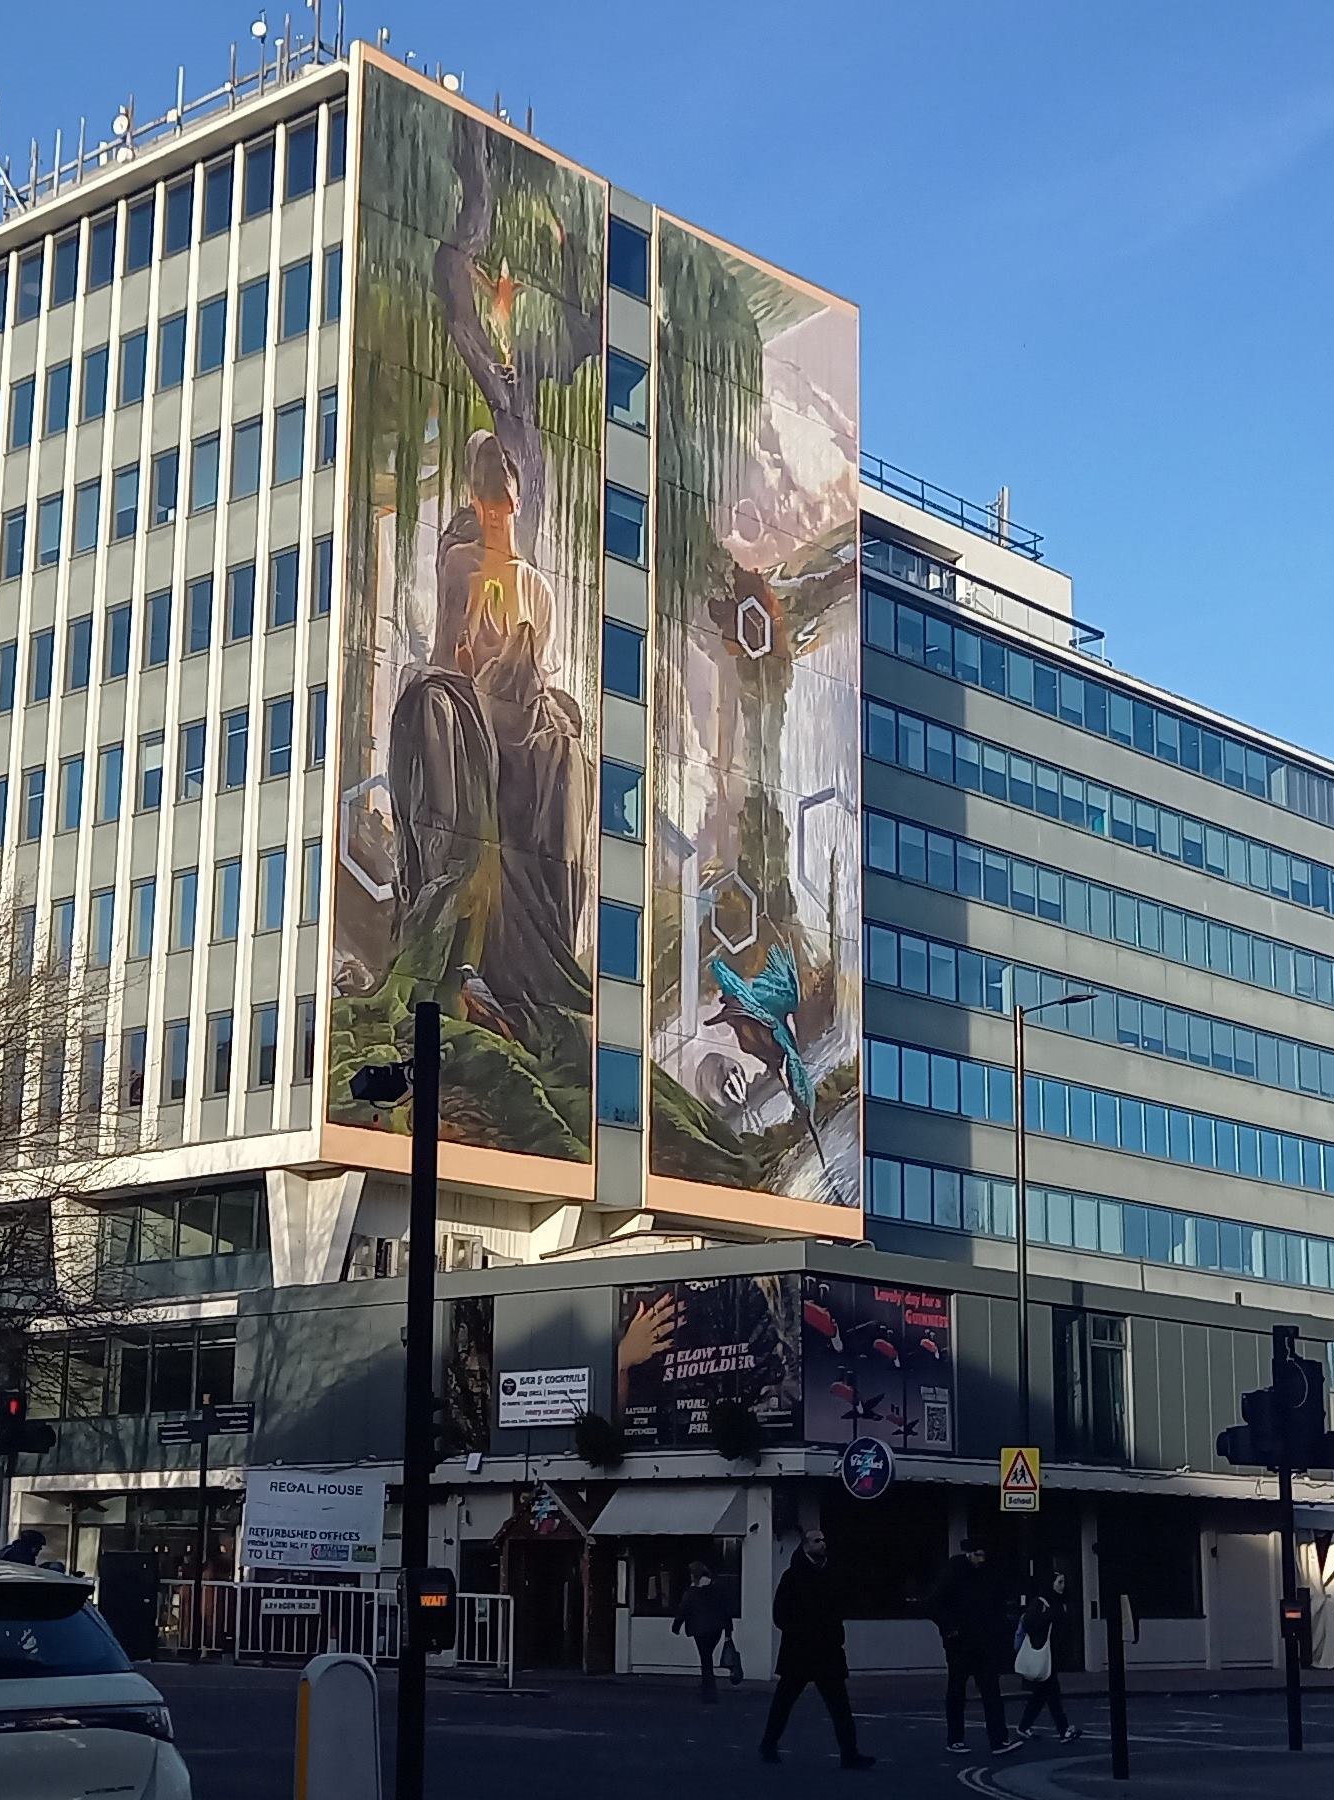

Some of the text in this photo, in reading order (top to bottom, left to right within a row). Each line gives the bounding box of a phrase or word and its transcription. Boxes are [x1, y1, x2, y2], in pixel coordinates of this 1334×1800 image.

[873, 1286, 902, 1306] Lovely
[904, 1292, 921, 1309] day
[921, 1293, 934, 1307] for
[664, 1342, 750, 1366] BELOW THE
[662, 1354, 756, 1382] SHOULDER
[520, 1376, 536, 1385] BAR
[544, 1374, 586, 1384] COCKTAILS
[269, 1481, 364, 1496] REGAL HOUSE
[1008, 1496, 1032, 1505] School
[248, 1527, 361, 1542] REFURBISHED OFFICES
[247, 1549, 284, 1561] TO LET
[420, 1595, 448, 1607] WAIT
